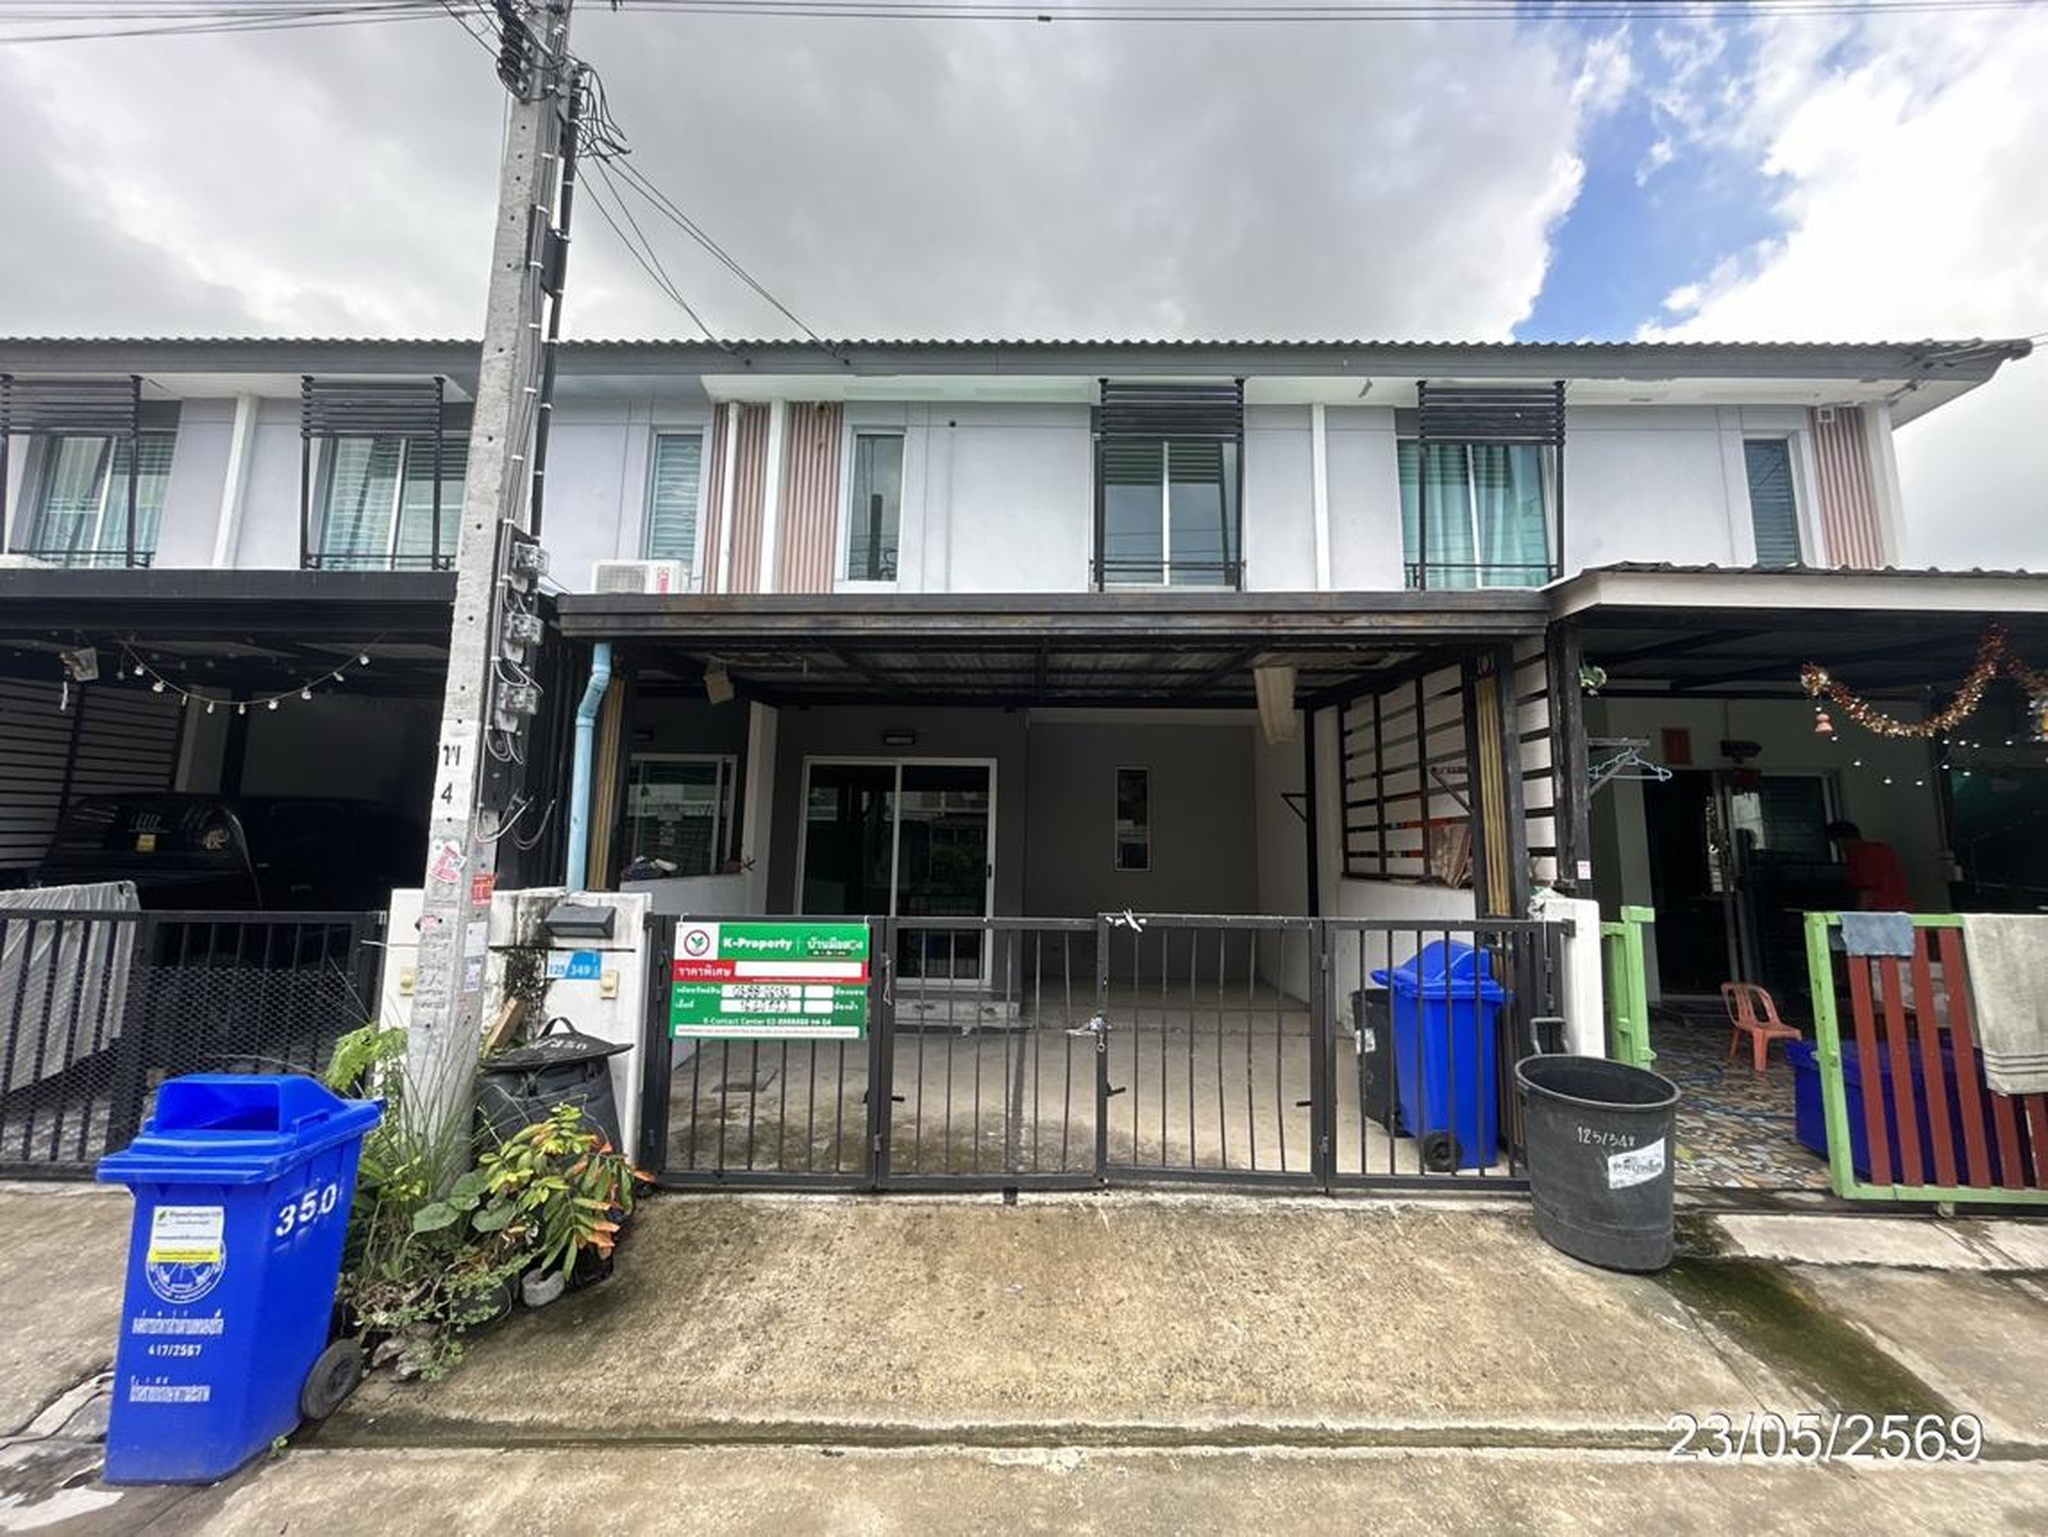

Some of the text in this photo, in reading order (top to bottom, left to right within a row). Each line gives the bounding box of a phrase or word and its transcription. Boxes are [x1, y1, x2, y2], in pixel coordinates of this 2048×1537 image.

[440, 781, 453, 804] 4
[723, 937, 793, 951] K-Property
[571, 964, 591, 976] 349
[678, 963, 732, 977] ราคาพิเศษ
[275, 1183, 337, 1236] 350
